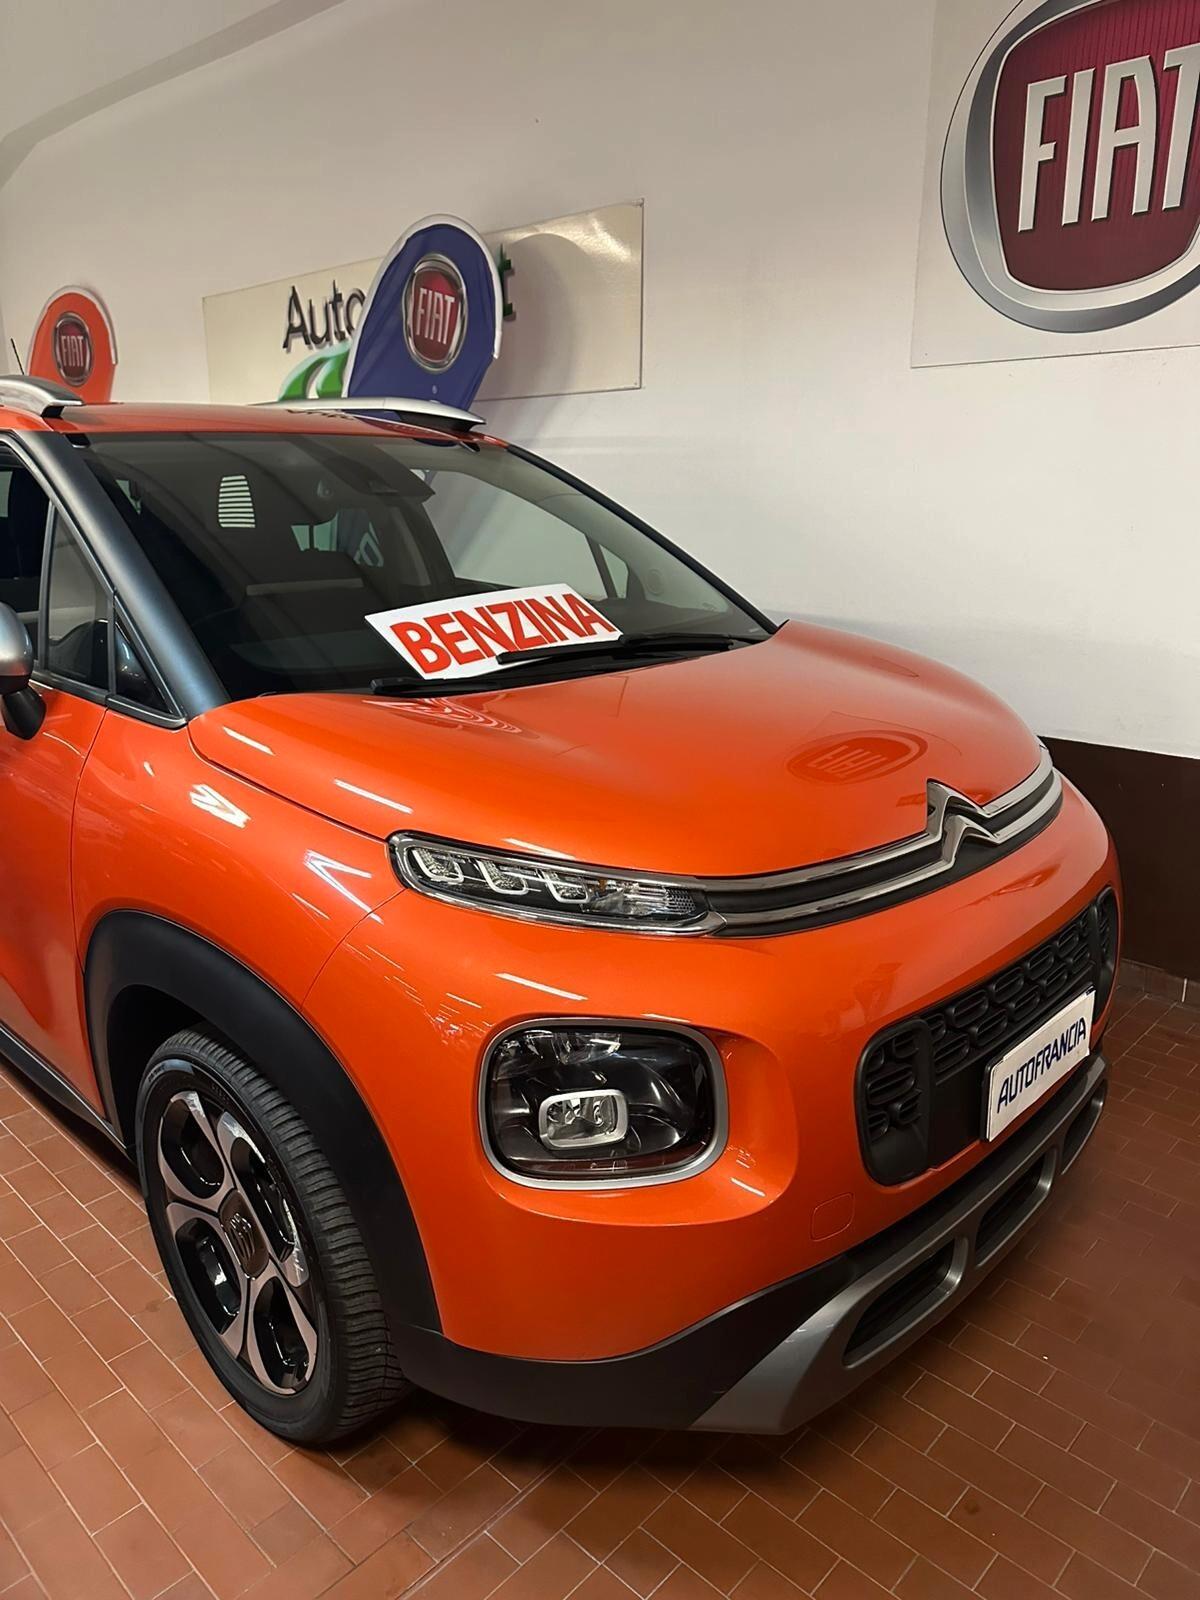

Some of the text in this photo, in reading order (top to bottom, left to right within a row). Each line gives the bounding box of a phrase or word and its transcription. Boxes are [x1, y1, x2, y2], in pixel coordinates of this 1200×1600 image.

[1017, 43, 1200, 233] FIAT
[61, 335, 84, 367] FIAT
[415, 287, 455, 345] FIAT
[390, 593, 617, 674] BENZINA
[997, 1017, 1086, 1113] AUTOFRANCIA
